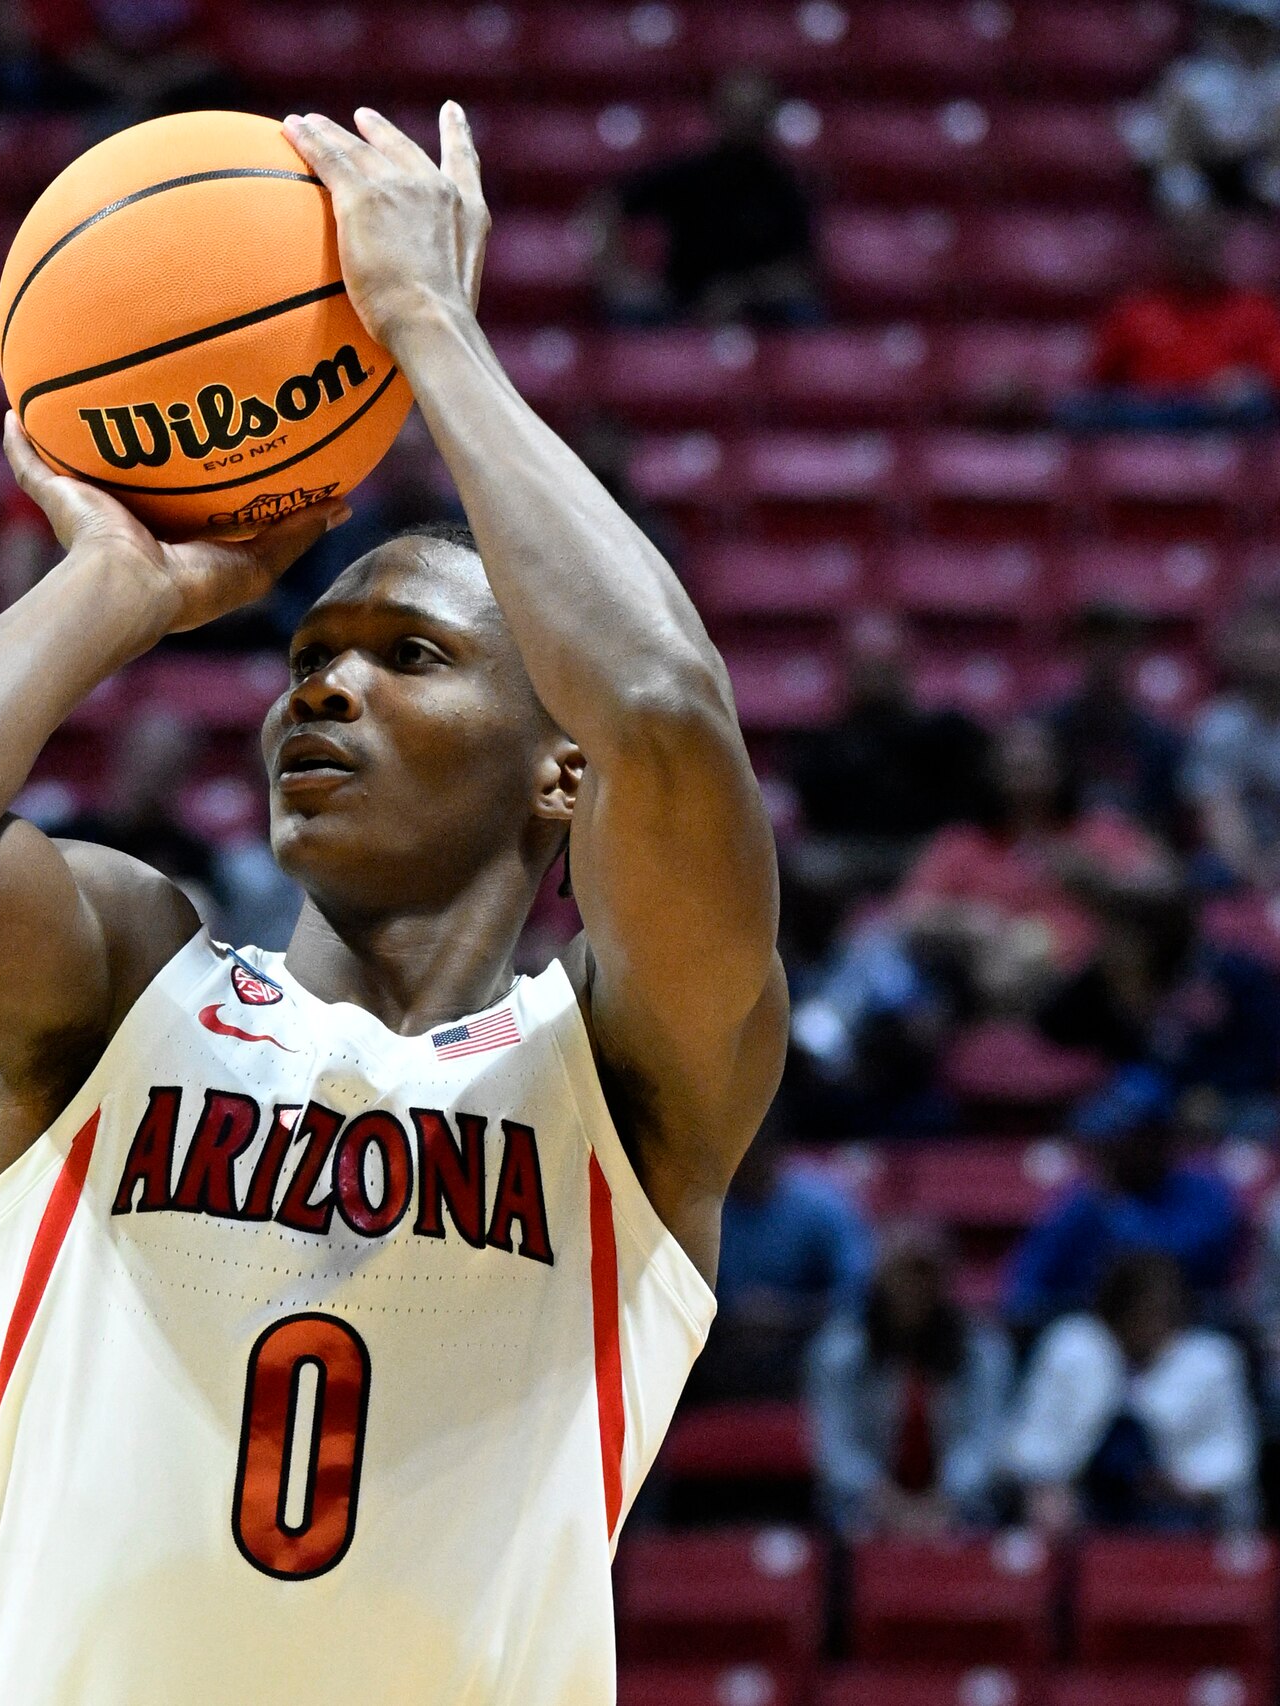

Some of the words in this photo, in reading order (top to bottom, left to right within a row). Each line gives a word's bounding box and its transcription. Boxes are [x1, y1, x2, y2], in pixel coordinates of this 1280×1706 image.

[79, 345, 368, 469] Wilson
[203, 453, 244, 471] EVO
[249, 434, 288, 457] NXT
[235, 487, 307, 525] FINAL
[111, 1086, 554, 1266] ARIZONA
[231, 1312, 372, 1581] 0
